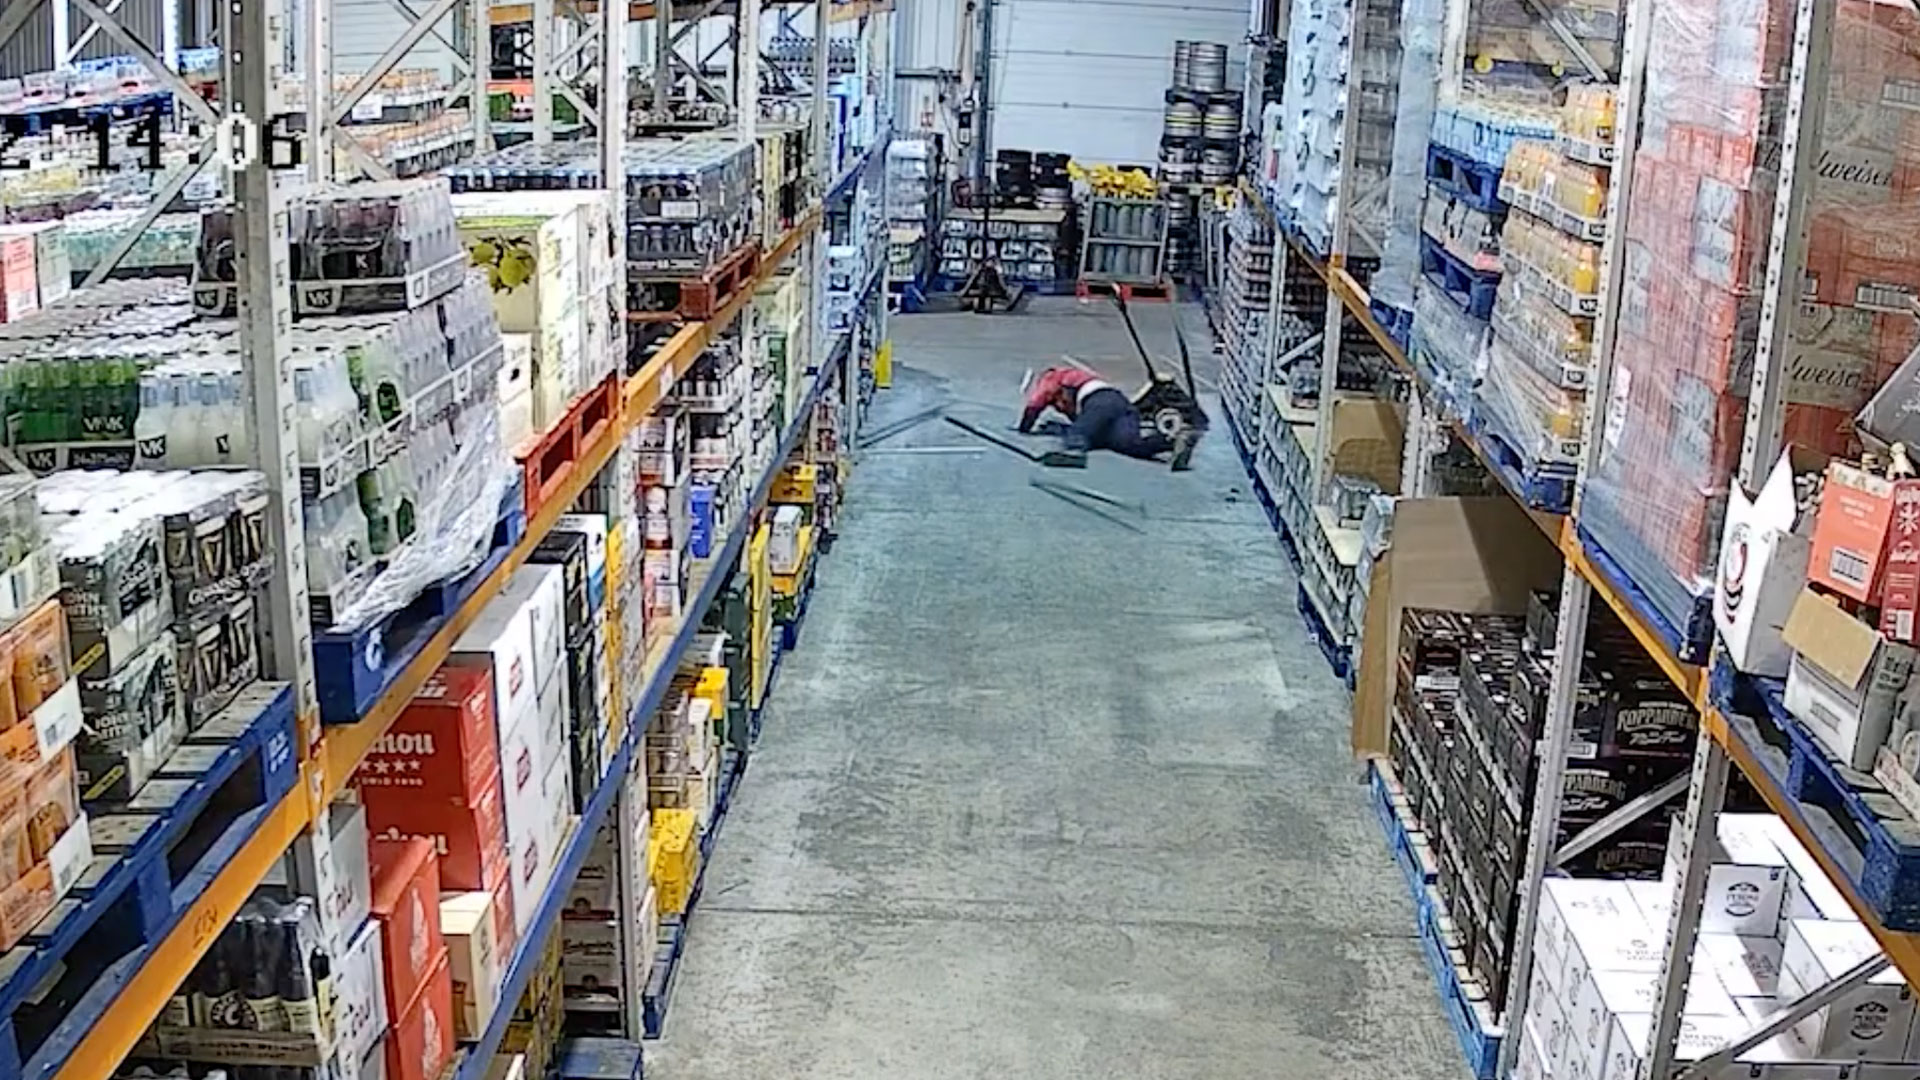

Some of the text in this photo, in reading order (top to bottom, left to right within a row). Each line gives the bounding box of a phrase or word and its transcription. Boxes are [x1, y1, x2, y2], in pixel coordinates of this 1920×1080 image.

[308, 290, 330, 307] VK
[140, 440, 165, 456] VK
[30, 452, 53, 468] VK
